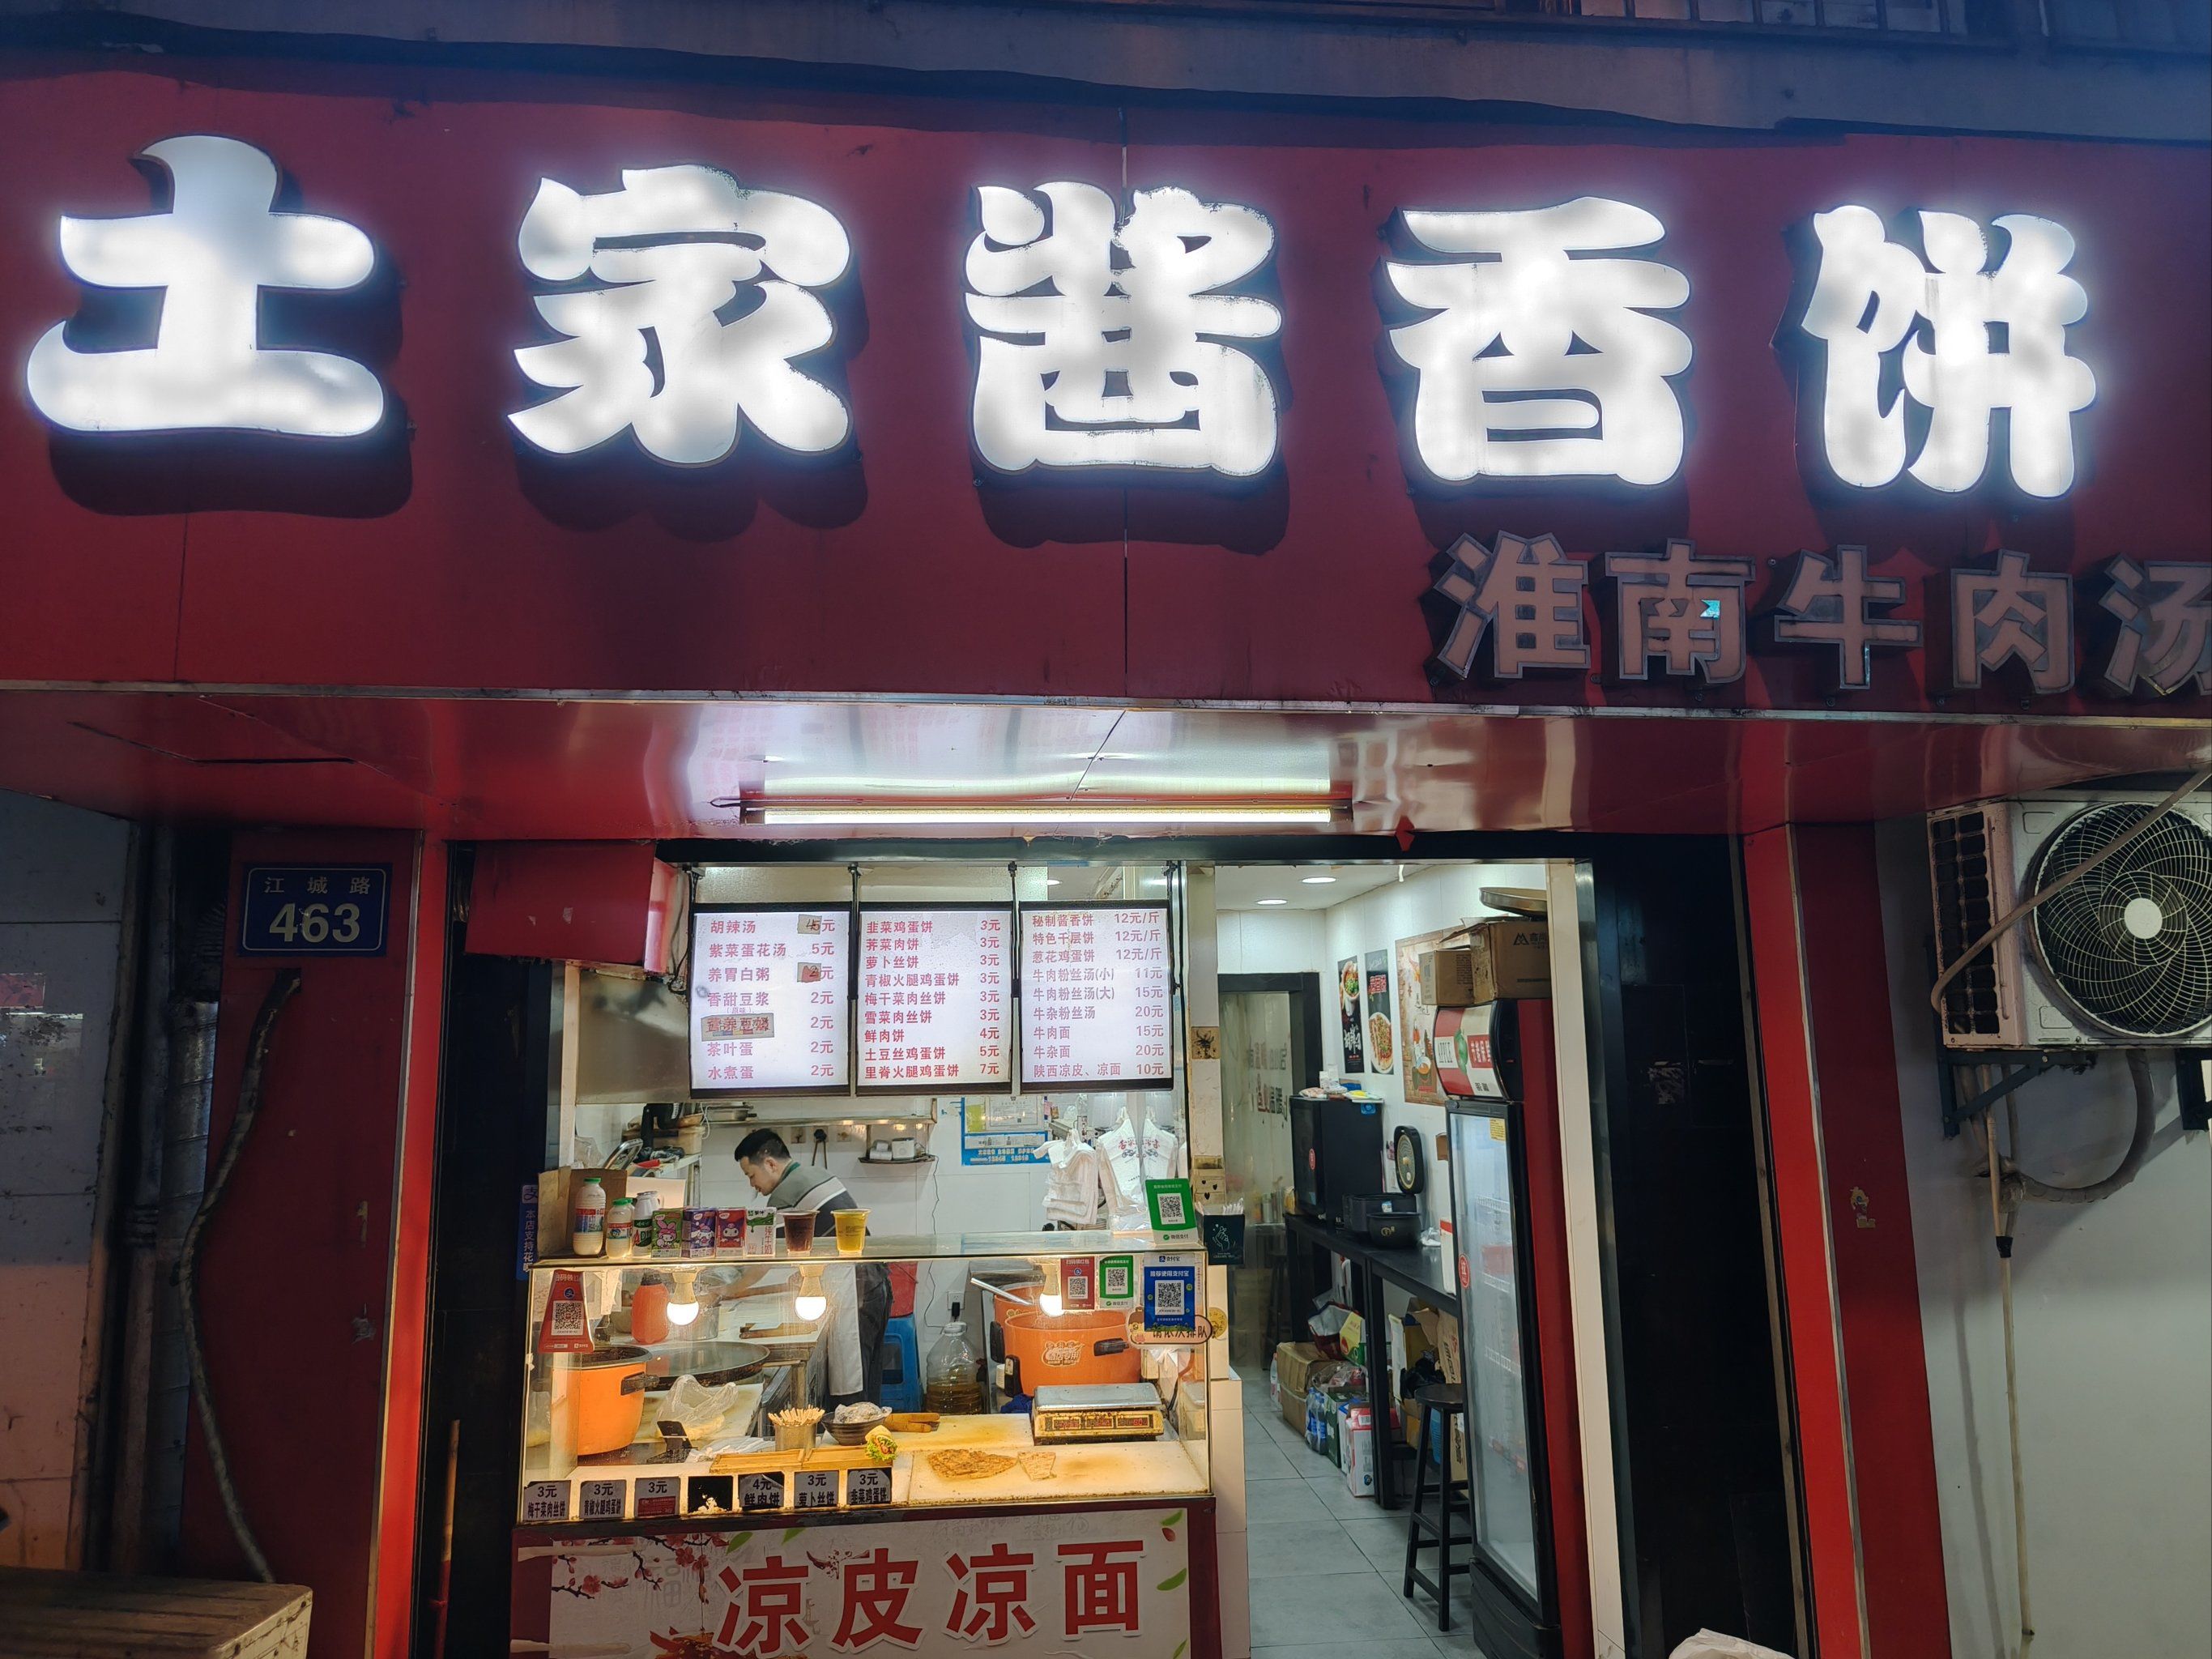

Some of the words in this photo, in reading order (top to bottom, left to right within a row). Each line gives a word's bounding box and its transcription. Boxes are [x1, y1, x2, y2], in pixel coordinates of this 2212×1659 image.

[27, 135, 2097, 499] 土家酱香饼
[1433, 530, 2212, 696] 淮南牛肉汤
[264, 876, 371, 894] 江城路
[269, 902, 360, 943] 463
[866, 921, 933, 934] 韭菜鸡蛋饼
[980, 919, 1000, 931] 3元
[1032, 914, 1094, 927] 秘制酱香饼
[1114, 911, 1160, 924] 12元/斤
[710, 920, 757, 934] 胡辣汤
[866, 938, 919, 951] 荠菜肉饼
[980, 937, 999, 949] 3元
[1033, 932, 1095, 945] 特色千层饼
[1115, 929, 1161, 943] 12元/斤
[710, 943, 786, 957] 紫菜蛋花汤
[812, 942, 835, 956] 5元
[1032, 949, 1095, 964] 葱花鸡蛋饼
[1116, 947, 1162, 961] 12元/斤
[866, 956, 919, 969] 萝卜丝饼
[980, 954, 1000, 966] 3元
[708, 967, 770, 982] 养胃白粥
[865, 973, 960, 987] 青椒火腿鸡蛋饼
[980, 972, 1000, 984] 3元
[1136, 966, 1162, 979] 11元
[707, 992, 769, 1007] 香甜豆浆
[811, 992, 834, 1004] 2元
[864, 992, 946, 1006] 梅干菜肉丝饼
[980, 991, 1000, 1003] 3元
[1136, 986, 1163, 998] 15元
[864, 1010, 932, 1024] 雪菜肉丝饼
[980, 1009, 1000, 1021] 3元
[1033, 1005, 1096, 1021] 牛杂粉丝汤
[1136, 1005, 1164, 1018] 20元
[811, 1016, 834, 1030] 2元
[864, 1029, 905, 1043] 鲜肉饼
[980, 1027, 999, 1039] 4元
[1034, 1026, 1071, 1039] 牛肉面
[1136, 1025, 1164, 1038] 15元
[707, 1042, 753, 1056] 茶叶蛋
[811, 1040, 834, 1054] 2元
[864, 1047, 946, 1061] 土豆丝鸡蛋饼
[980, 1045, 999, 1057] 5元
[1034, 1045, 1071, 1059] 牛杂面
[1136, 1043, 1164, 1056] 20元
[708, 1066, 754, 1080] 水煮蛋
[811, 1064, 834, 1077] 2元
[865, 1064, 960, 1079] 里脊火腿鸡蛋饼
[980, 1063, 999, 1075] 7元
[1136, 1062, 1164, 1075] 10元
[752, 1478, 772, 1491] 4元
[808, 1473, 827, 1486] 3元
[859, 1473, 879, 1486] 3元
[537, 1485, 557, 1498] 3元
[594, 1483, 614, 1496] 3元
[648, 1481, 668, 1494] 3元
[744, 1492, 780, 1506] 鲜肉饼
[799, 1491, 835, 1508] 萝卜丝饼
[850, 1487, 888, 1504] 韭菜鸡蛋饼
[527, 1500, 566, 1518] 梅干菜肉丝饼
[584, 1498, 622, 1516] 青椒火腿鸡蛋饼
[716, 1540, 1144, 1654] 凉皮凉面
